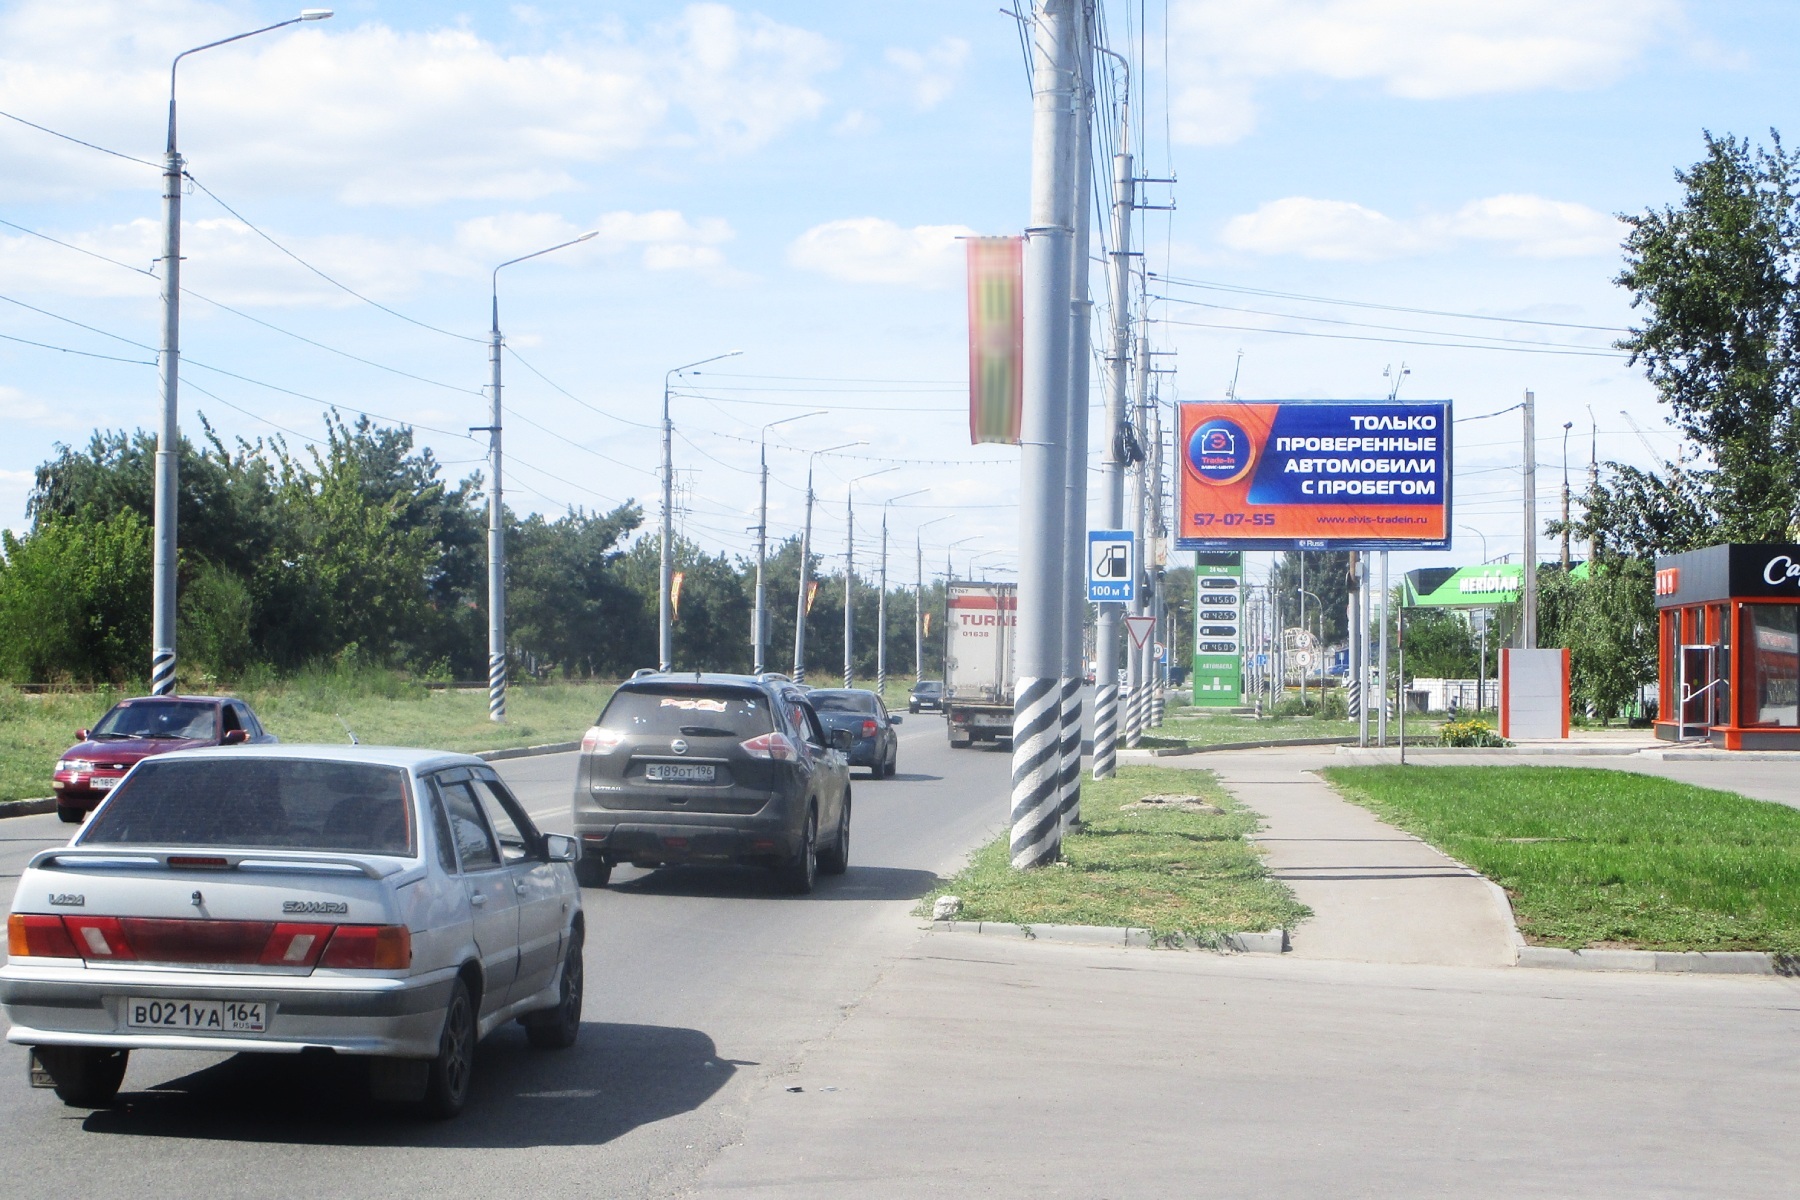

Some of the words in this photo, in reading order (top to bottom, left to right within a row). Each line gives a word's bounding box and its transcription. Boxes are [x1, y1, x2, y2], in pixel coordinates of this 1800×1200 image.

[1350, 415, 1437, 431] ТОЛЬКО
[1276, 437, 1437, 451] ПРОВЕРЕННЫЕ
[1284, 459, 1436, 473] АВТОМОБИЛИ
[1301, 480, 1314, 495] С
[1318, 480, 1436, 495] ПРОБЕГОМ
[1193, 513, 1276, 526] 57-07-55
[1316, 515, 1428, 524] www.elvis-tradein.ru
[1763, 555, 1800, 587] Ca
[1091, 586, 1111, 596] 100
[1301, 654, 1306, 662] 5
[695, 766, 712, 775] 196
[49, 893, 86, 906] LADA
[282, 901, 349, 914] SAMARA
[135, 1001, 220, 1027] В021УА
[227, 1004, 261, 1022] 164
[233, 1021, 250, 1029] RUS
